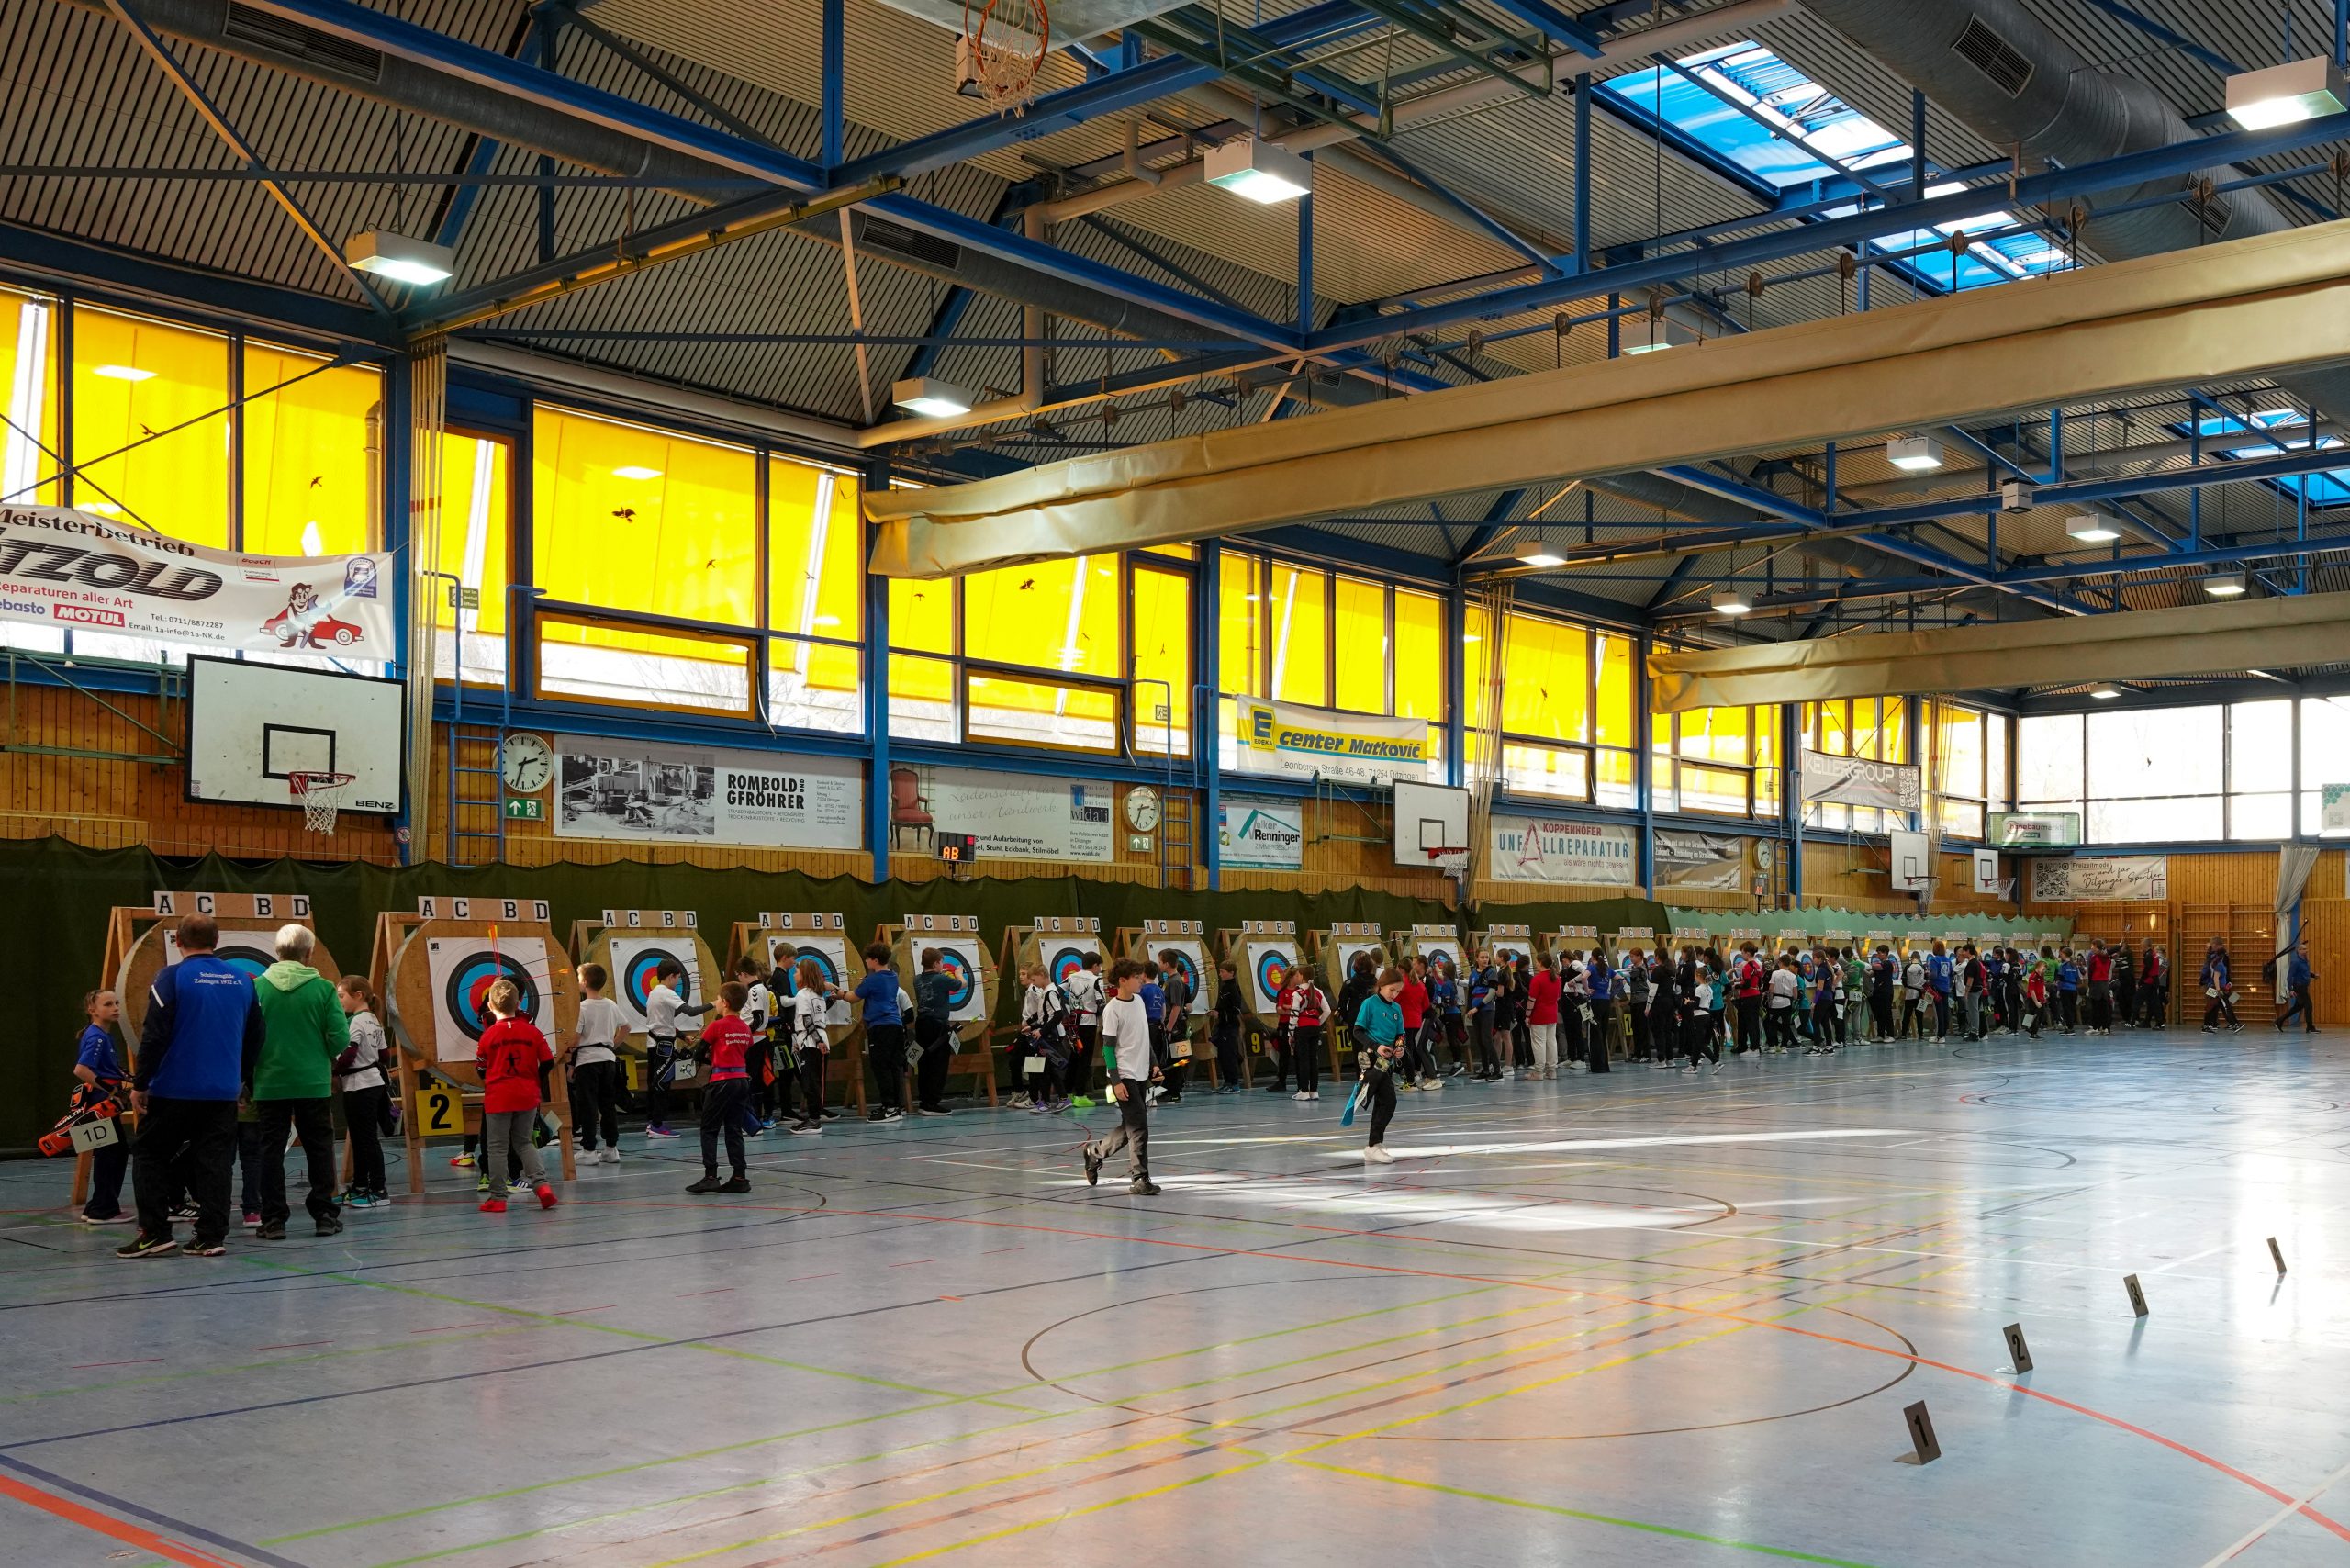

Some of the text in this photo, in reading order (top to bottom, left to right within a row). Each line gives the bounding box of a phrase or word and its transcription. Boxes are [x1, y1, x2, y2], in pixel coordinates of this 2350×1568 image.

[0, 536, 223, 602] TZOLD
[0, 581, 133, 610] eparaturen aller Art
[0, 598, 124, 626] basto MOTUL
[151, 613, 224, 629] Tel.: 0711/8872287
[129, 622, 225, 641] Email: 1a-info@1a-NK.de
[1280, 730, 1421, 758] center Matković
[1280, 759, 1319, 774] Leonberger
[1321, 766, 1343, 776] Straße
[1369, 768, 1388, 778] 71254
[727, 774, 797, 792] ROMBOLD
[355, 800, 393, 809] BENZ
[727, 790, 804, 809] GFRÖHRER
[1070, 808, 1109, 823] widali
[993, 835, 1031, 845] Aufarbeitung
[1255, 829, 1300, 845] Renninger
[943, 846, 959, 860] AB
[986, 846, 1003, 854] Stuhl,
[1005, 846, 1031, 855] Eckbank,
[159, 895, 308, 916] A C B D
[422, 900, 548, 920] A C B D
[606, 912, 696, 926] A C B D
[762, 914, 843, 927] A C B D
[907, 917, 977, 929] A C B D
[1037, 919, 1099, 930] A C B D
[1146, 922, 1203, 933] A C B D
[1244, 923, 1294, 932] A C B D
[1334, 924, 1380, 934] A C B D
[1250, 1032, 1260, 1054] 9
[1337, 1029, 1352, 1048] 10
[908, 1048, 919, 1060] 5A
[1175, 1044, 1188, 1056] 7C
[429, 1093, 452, 1130] 2
[83, 1126, 107, 1143] 1D
[2130, 1282, 2142, 1306] 3
[2011, 1334, 2025, 1361] 2
[1914, 1415, 1929, 1448] 1
